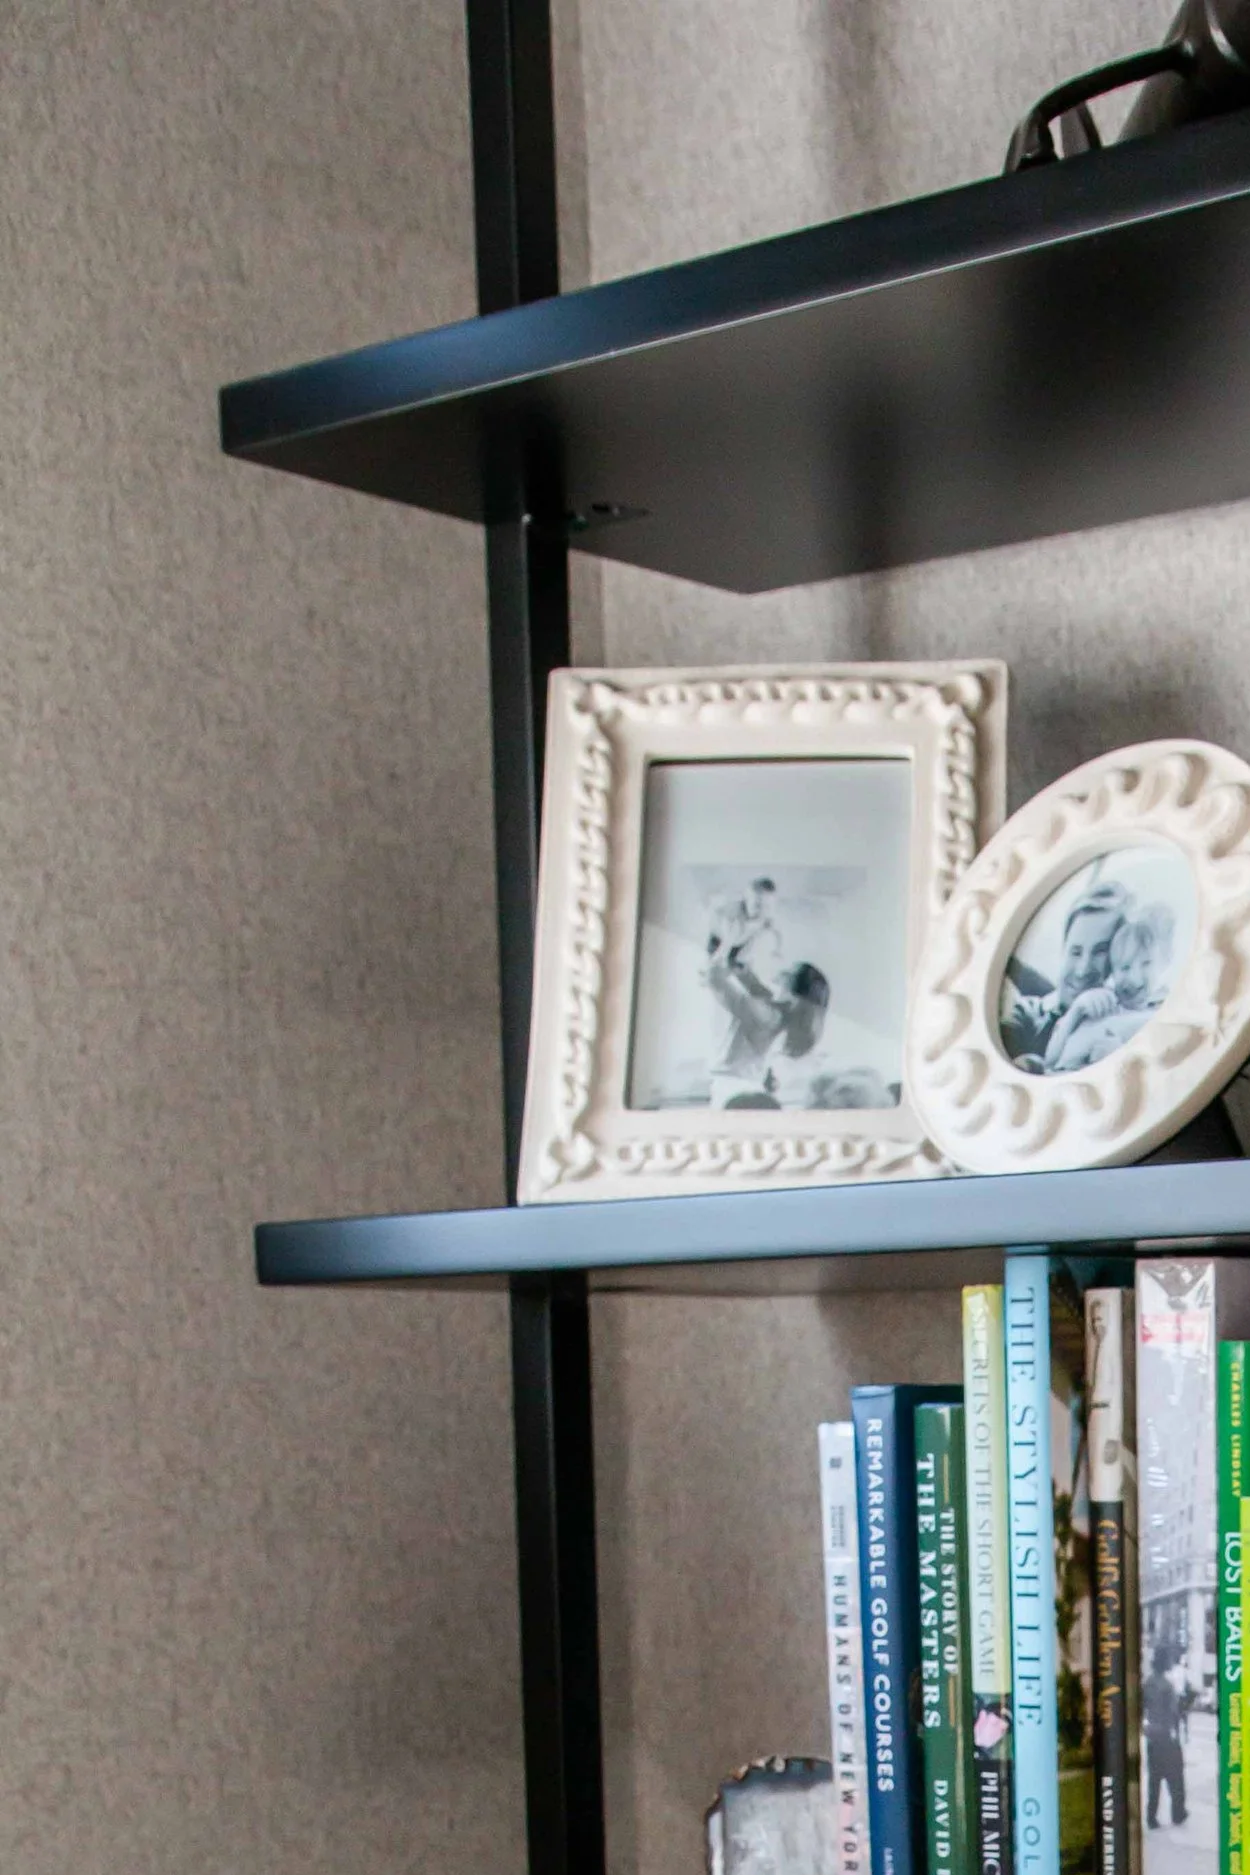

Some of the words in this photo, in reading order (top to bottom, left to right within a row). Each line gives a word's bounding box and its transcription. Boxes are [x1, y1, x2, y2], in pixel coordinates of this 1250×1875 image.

[1010, 1287, 1036, 1383] THE
[1230, 1362, 1243, 1428] CHARLES
[866, 1417, 887, 1590] REMARKABLE
[917, 1452, 936, 1534] THE
[975, 1461, 994, 1513] THE
[1013, 1404, 1039, 1598] STYLISH
[1230, 1434, 1243, 1498] LINDSAY
[940, 1507, 956, 1556] THE
[975, 1518, 994, 1602] SHORT
[1225, 1532, 1242, 1594] LOST
[833, 1575, 853, 1685] HUMANS
[870, 1597, 891, 1667] GOLF
[941, 1562, 959, 1638] STORY
[919, 1551, 942, 1729] MASTERS
[943, 1645, 959, 1676] OF
[977, 1609, 996, 1677] GAME
[1017, 1624, 1043, 1726] LIFE
[1225, 1606, 1242, 1682] BALLS
[837, 1703, 854, 1734] OF
[873, 1673, 895, 1793] COURSES
[839, 1752, 857, 1806] NEW
[981, 1771, 1000, 1825] PHIL
[933, 1779, 951, 1858] DAVID
